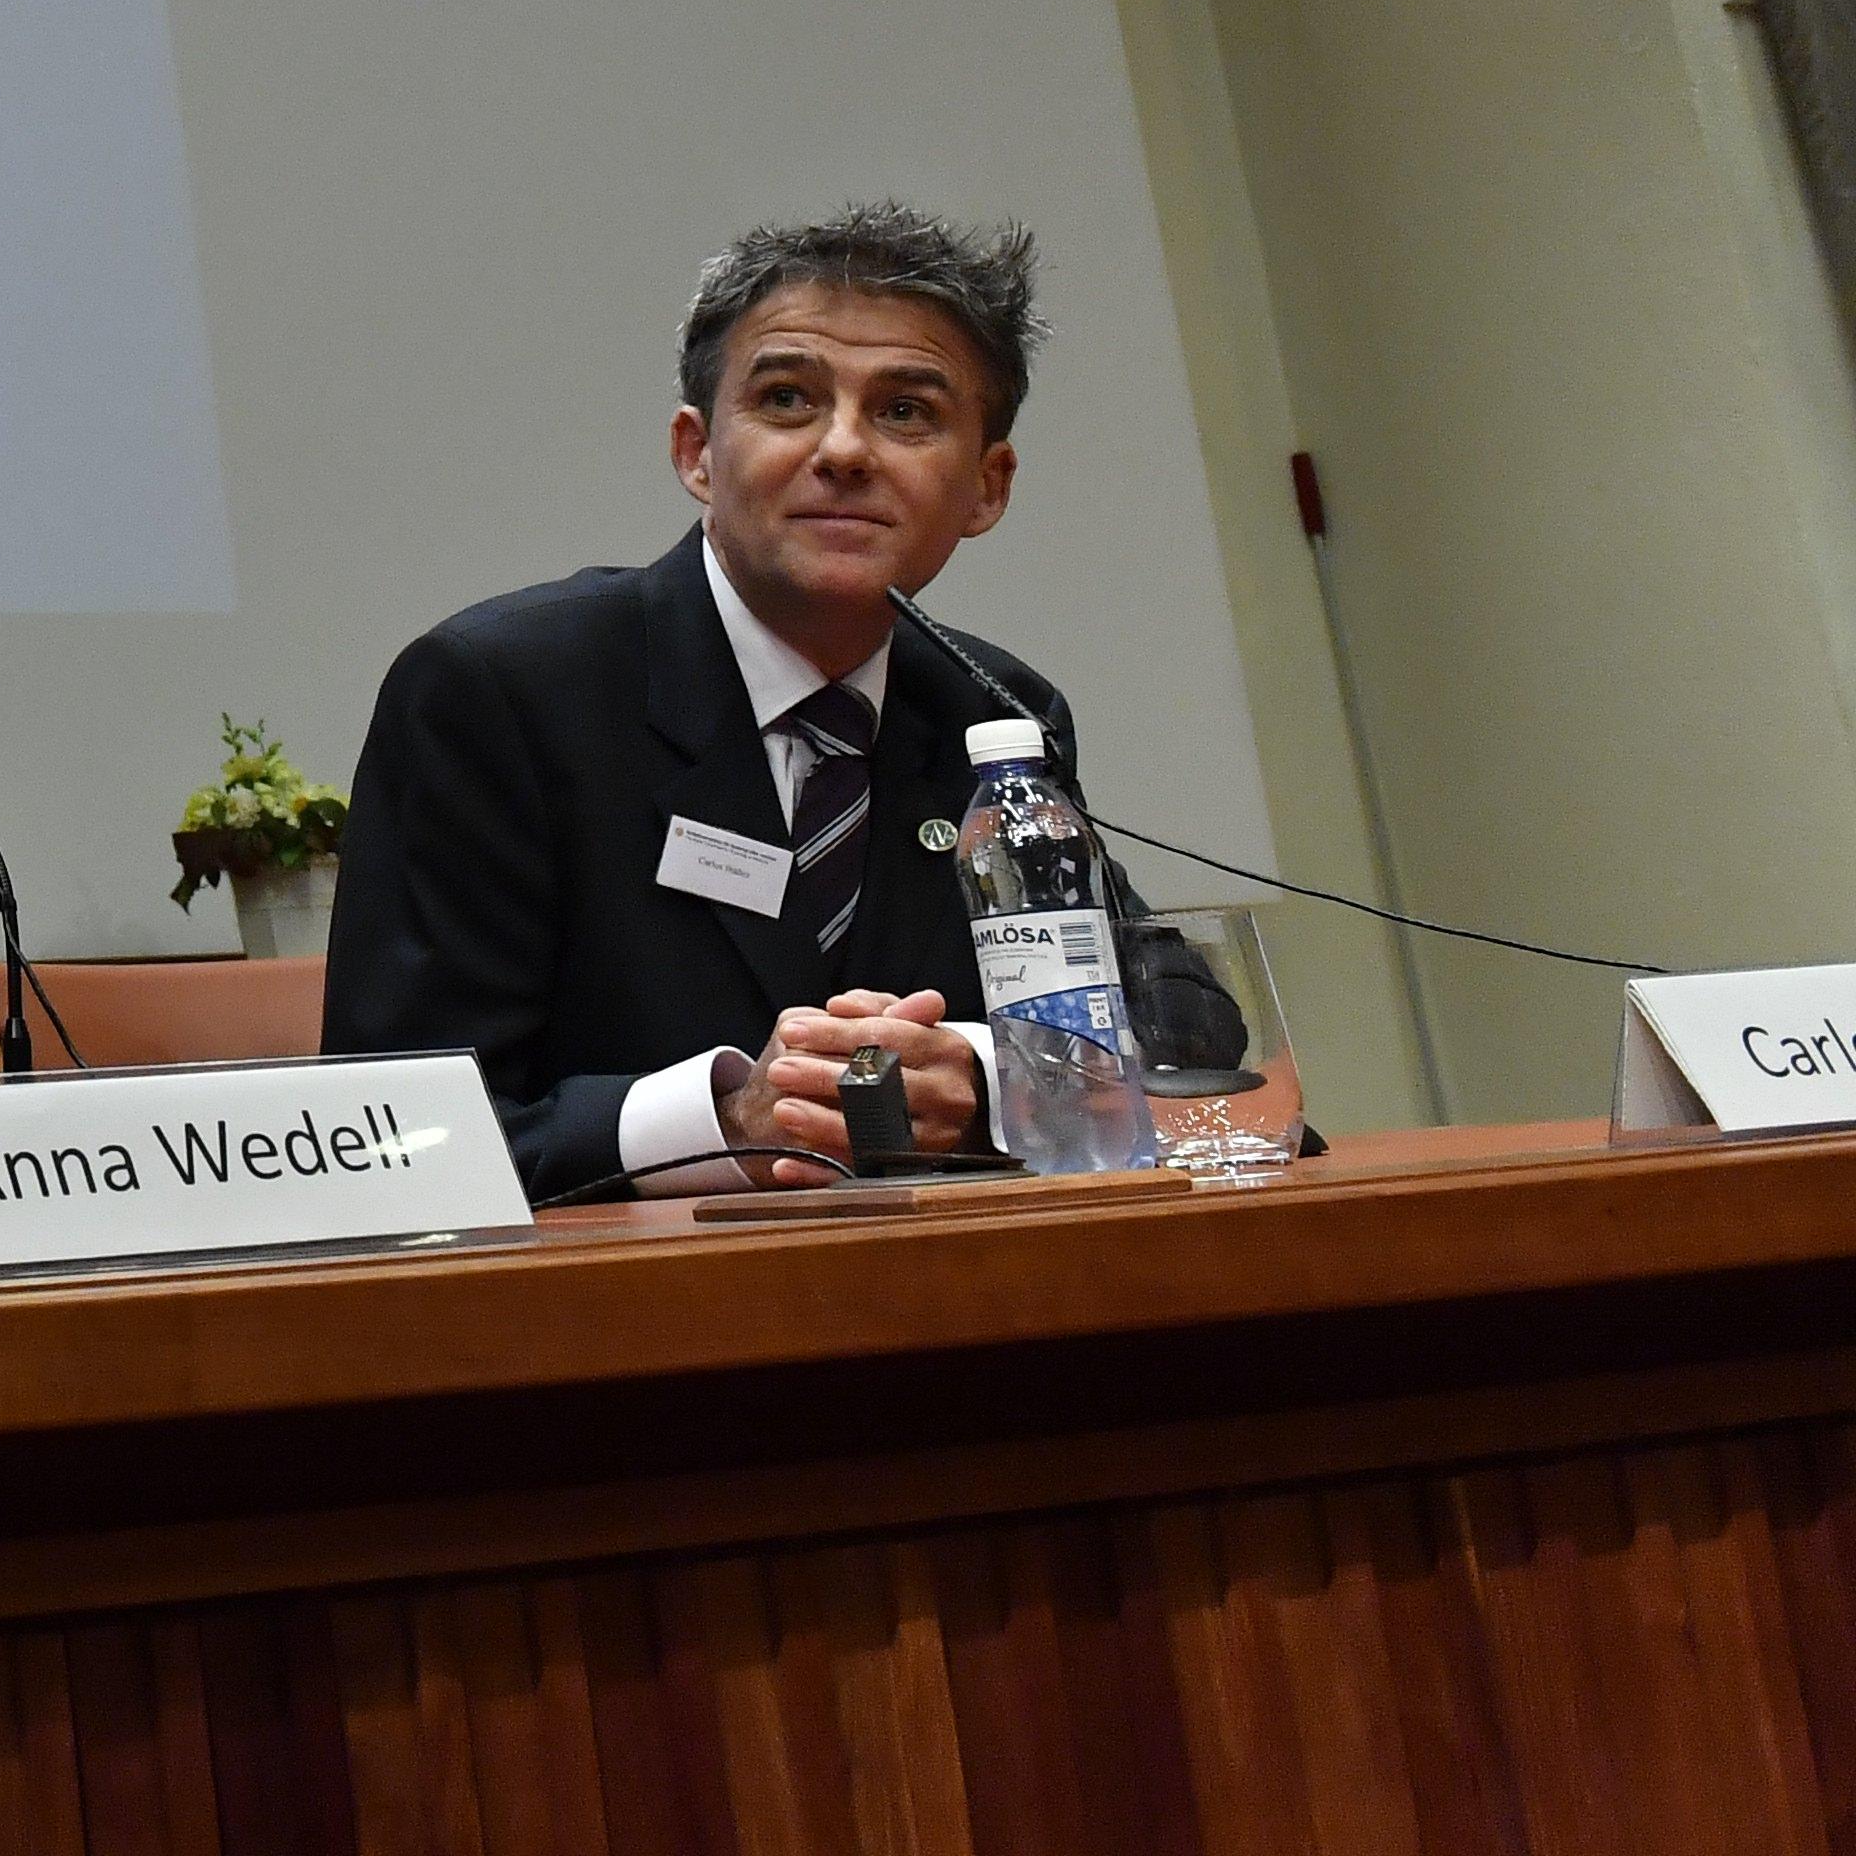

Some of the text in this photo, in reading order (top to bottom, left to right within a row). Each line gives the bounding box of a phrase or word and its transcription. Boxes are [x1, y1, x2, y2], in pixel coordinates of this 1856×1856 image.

[974, 922, 1056, 948] AMLÖSA
[1741, 1017, 1856, 1079] Carl
[151, 1103, 412, 1187] Wedell
